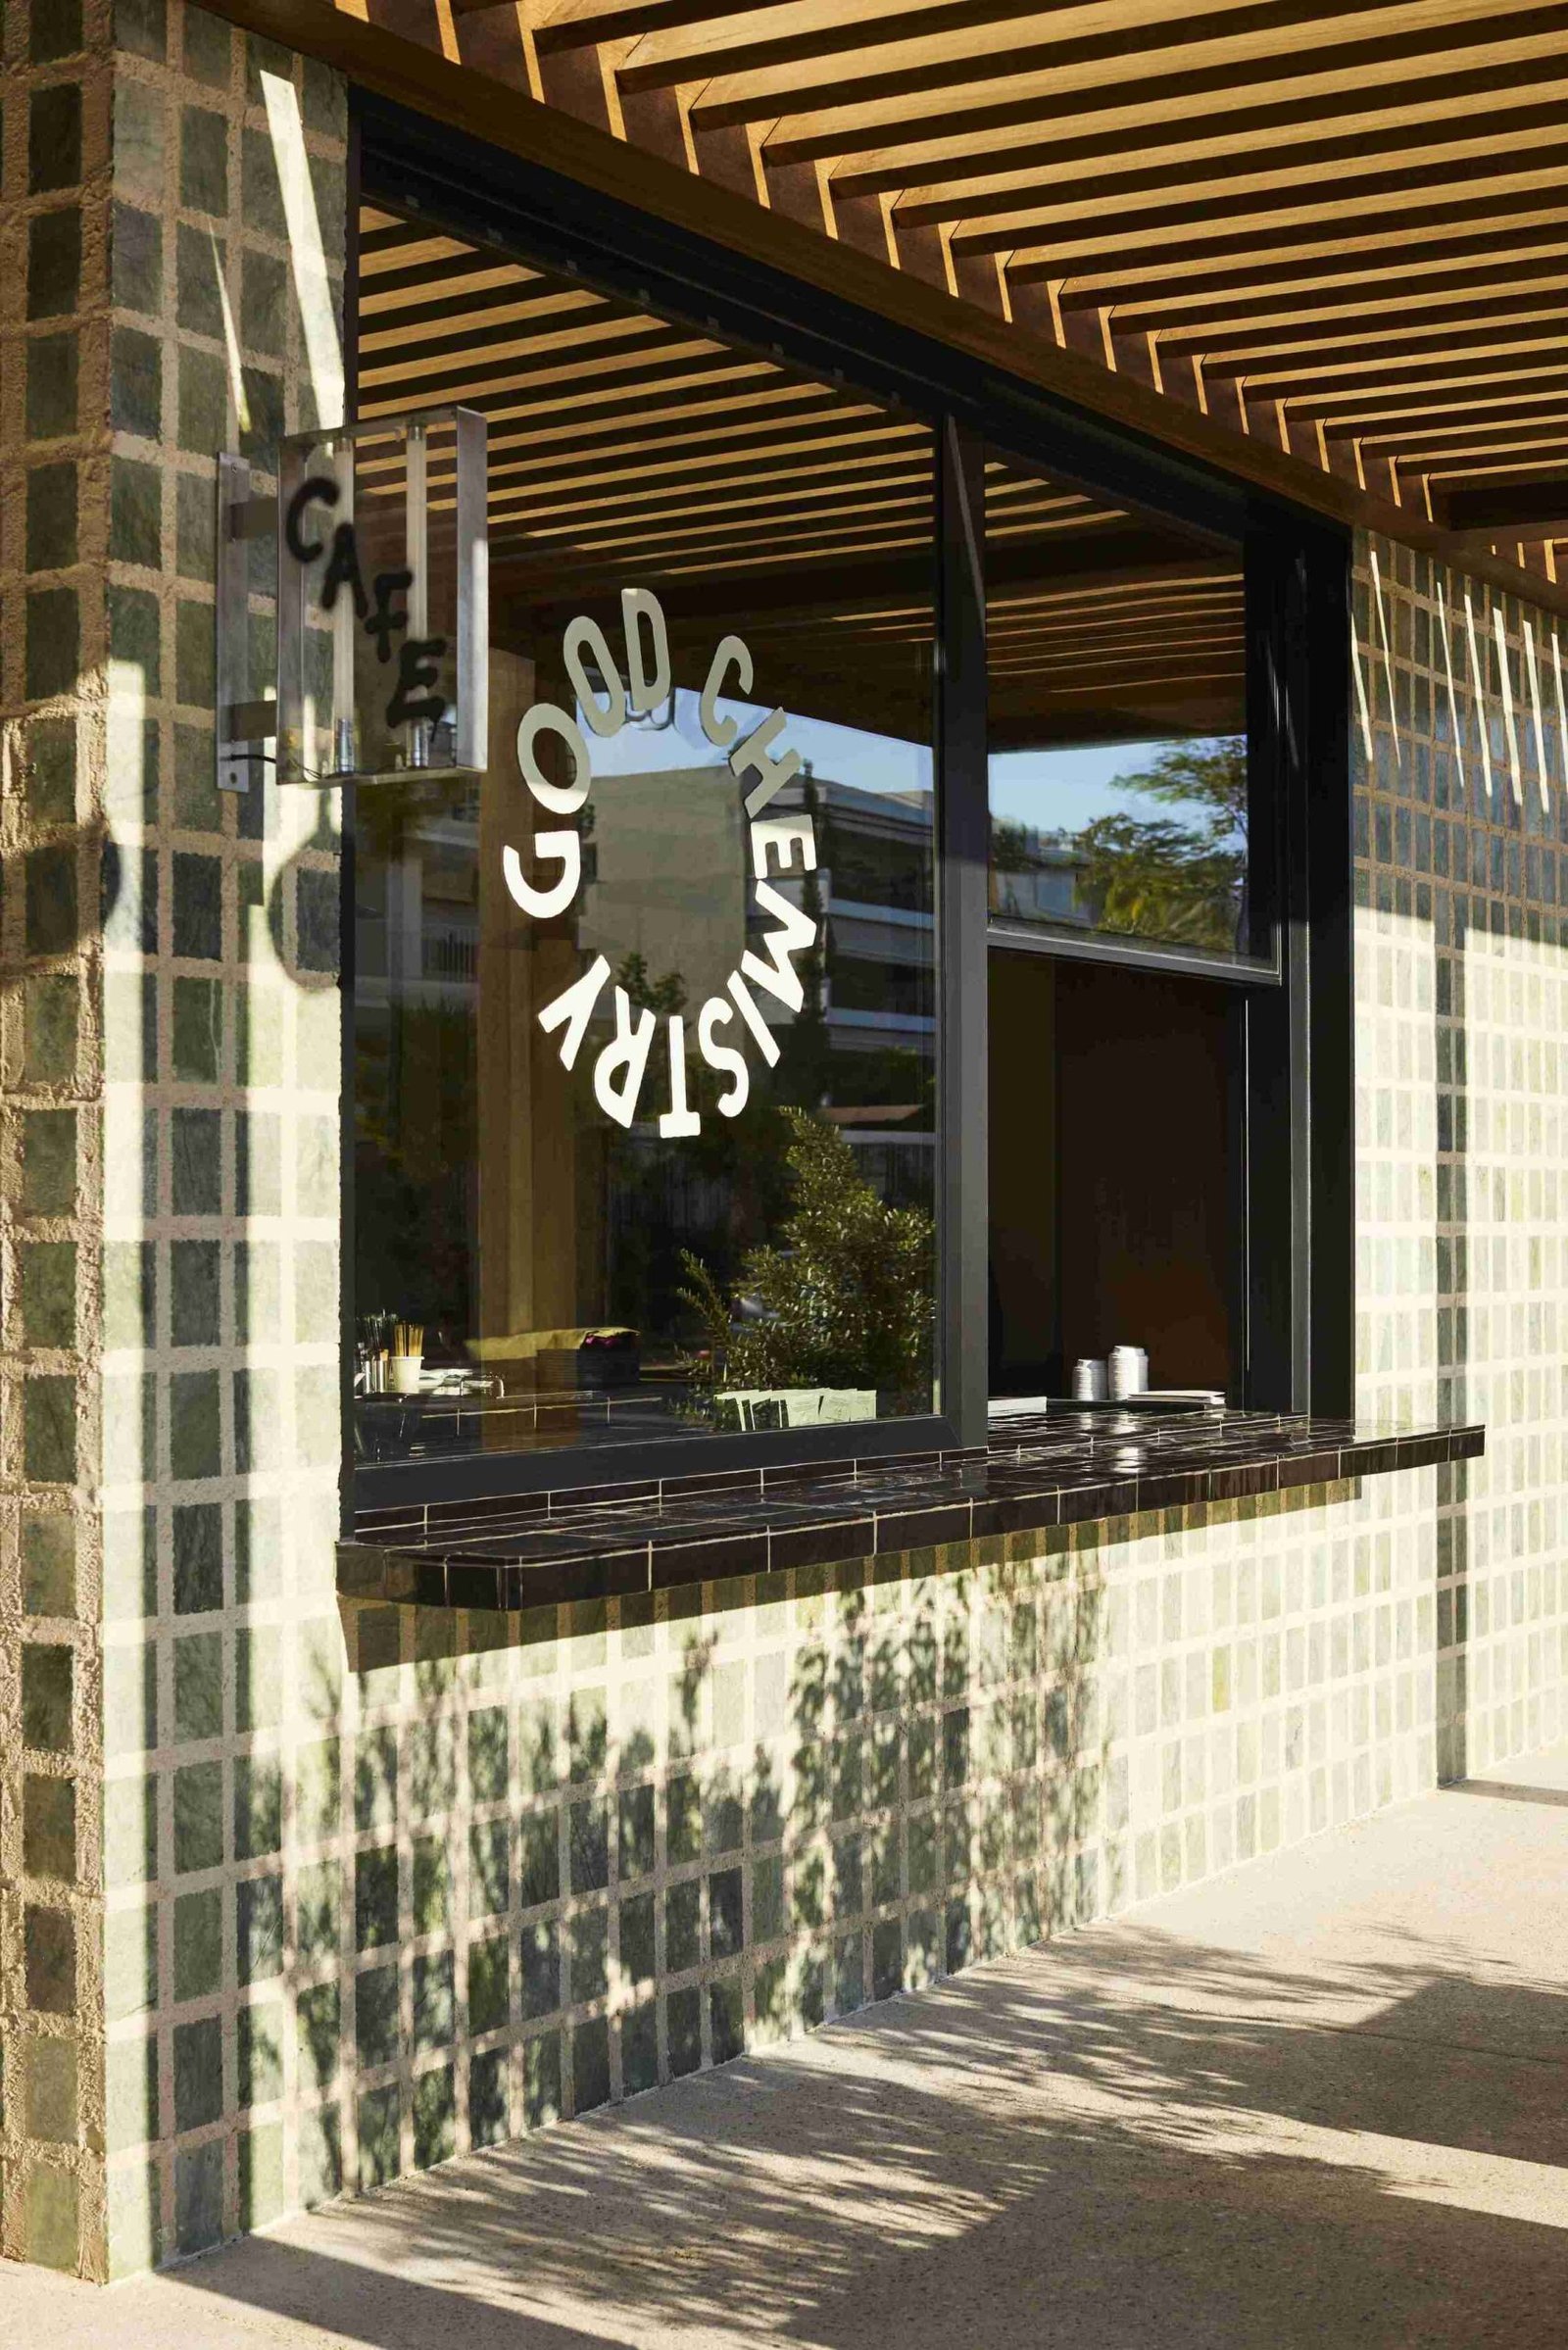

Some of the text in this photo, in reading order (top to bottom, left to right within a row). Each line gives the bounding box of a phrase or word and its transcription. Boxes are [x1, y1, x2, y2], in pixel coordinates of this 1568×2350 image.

[286, 476, 447, 735] CAFE
[503, 588, 817, 1138] GOOD CHEMISTRY
